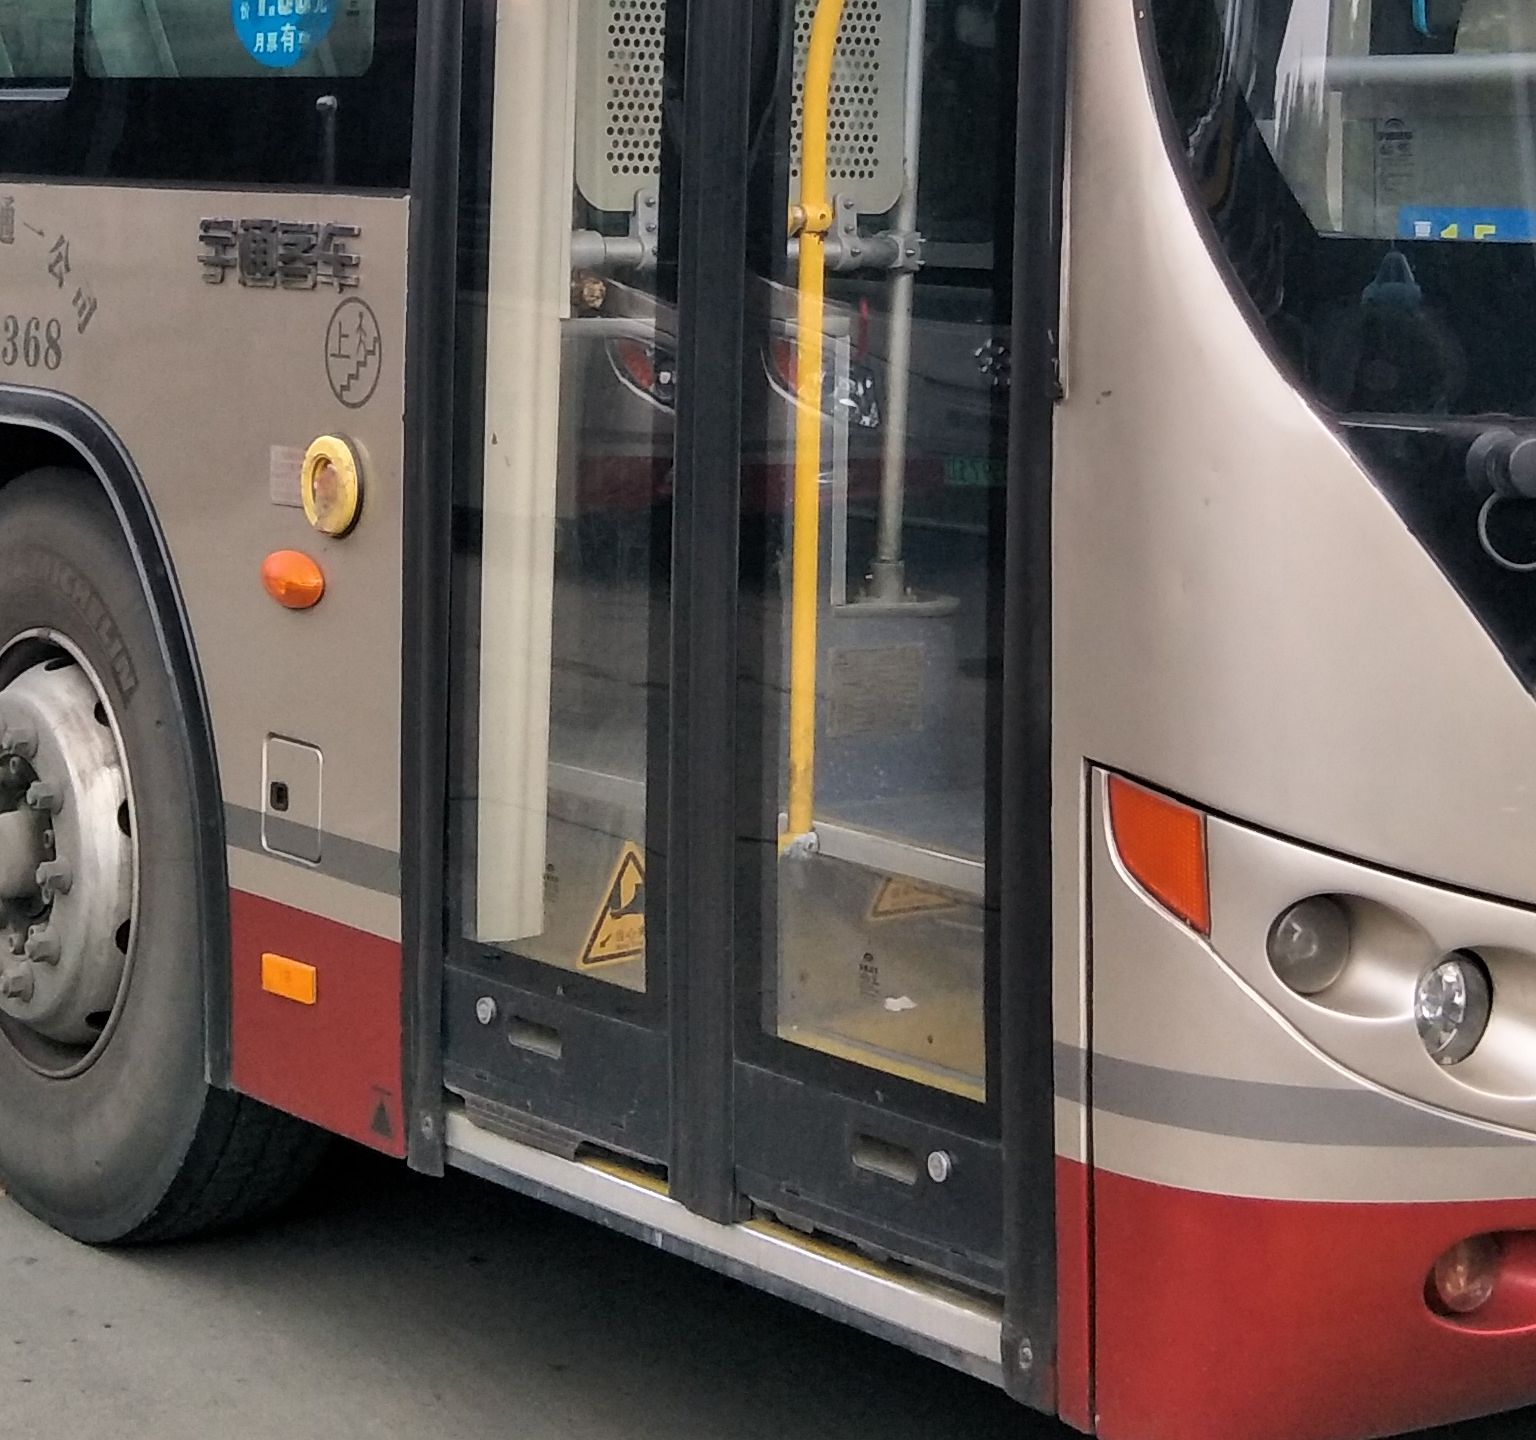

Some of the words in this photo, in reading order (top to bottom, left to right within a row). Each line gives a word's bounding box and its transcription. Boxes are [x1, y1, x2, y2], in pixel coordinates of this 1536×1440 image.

[197, 216, 361, 294] 宇通客车
[329, 321, 351, 360] 上
